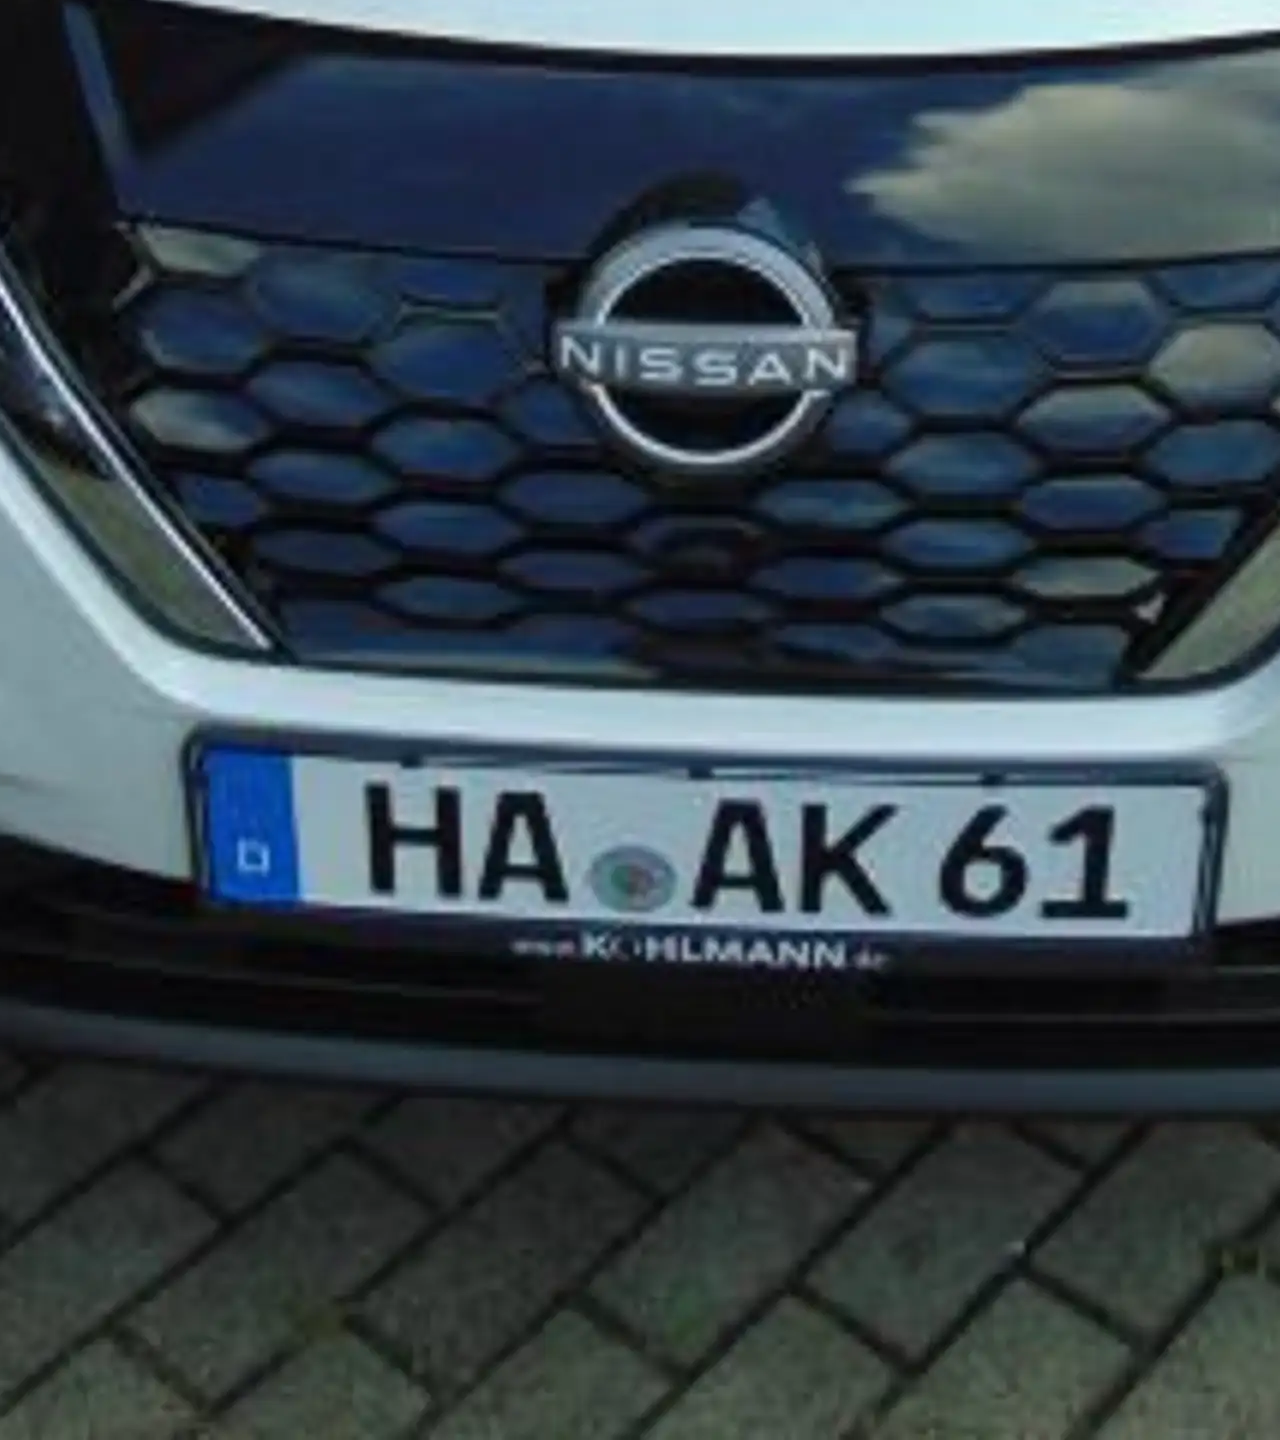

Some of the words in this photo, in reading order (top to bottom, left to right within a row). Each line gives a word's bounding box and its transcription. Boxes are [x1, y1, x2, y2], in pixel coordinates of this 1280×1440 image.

[560, 335, 848, 386] NISSAN
[364, 783, 569, 902] HA
[687, 798, 901, 917] AK
[936, 803, 1130, 920] 61
